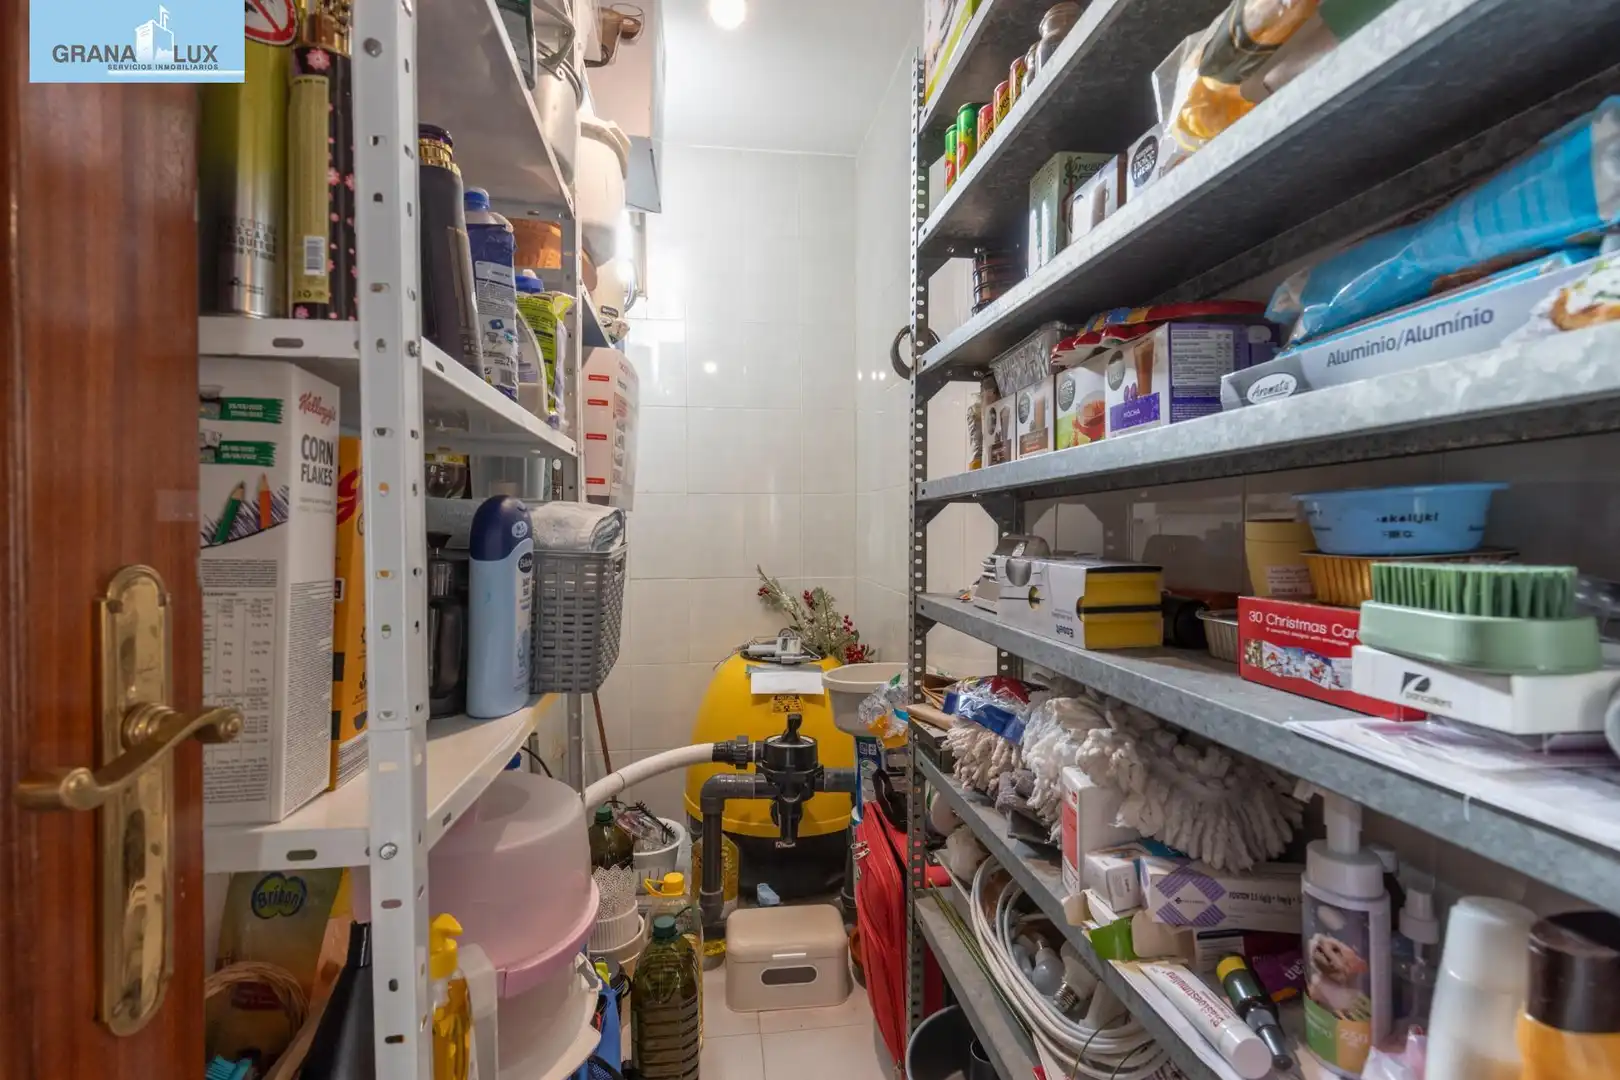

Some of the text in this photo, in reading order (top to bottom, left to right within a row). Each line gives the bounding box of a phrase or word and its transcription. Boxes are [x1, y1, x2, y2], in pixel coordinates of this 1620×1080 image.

[298, 391, 336, 426] Kellogg's
[301, 433, 334, 466] CORN
[300, 464, 333, 487] FLAKES
[1248, 610, 1263, 623] 30
[1265, 612, 1327, 635] Christmas
